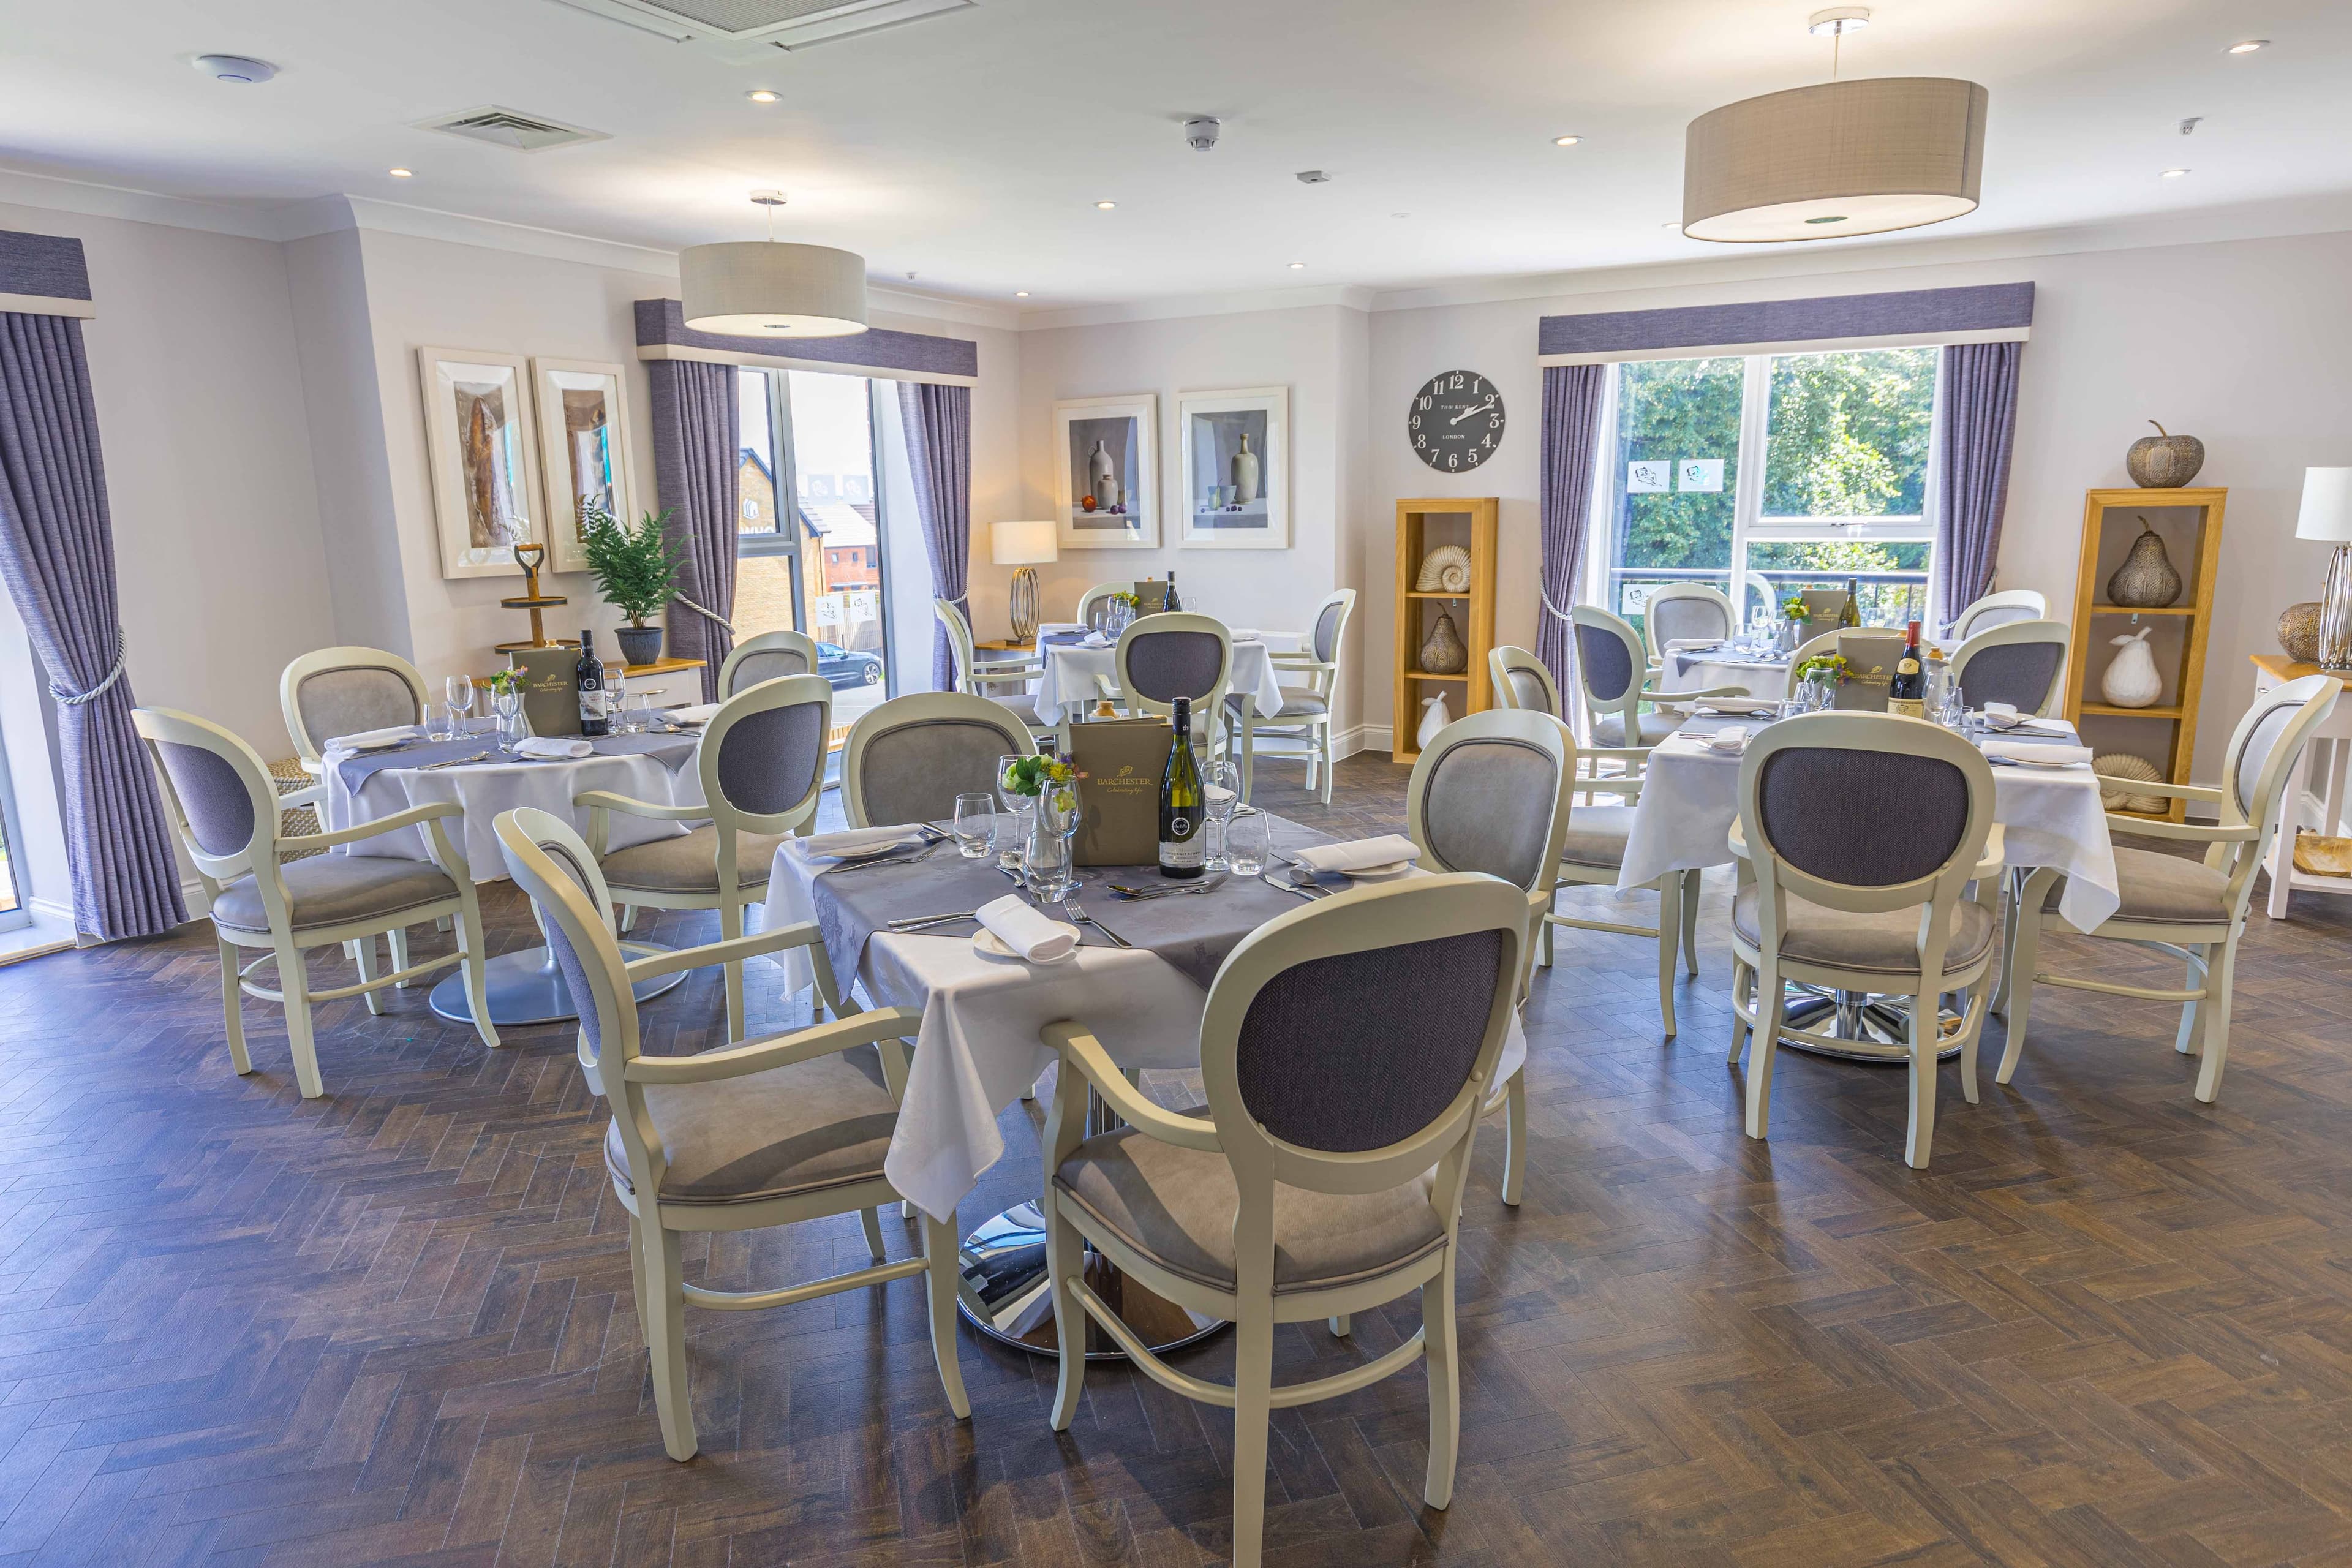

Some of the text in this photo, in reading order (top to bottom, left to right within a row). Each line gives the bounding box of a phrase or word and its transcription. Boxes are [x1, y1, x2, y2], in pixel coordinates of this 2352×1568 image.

[1433, 380, 1445, 395] 11
[1449, 374, 1464, 390] 12
[1472, 379, 1479, 394] 1
[1419, 395, 1433, 410] 10
[1485, 394, 1496, 409] 2
[1412, 415, 1421, 430] 9
[1489, 413, 1500, 429] 3
[1417, 434, 1427, 449] 8
[1480, 433, 1492, 448] 4
[1431, 448, 1440, 462] 7
[1448, 453, 1458, 468] 6
[1468, 448, 1478, 463] 5
